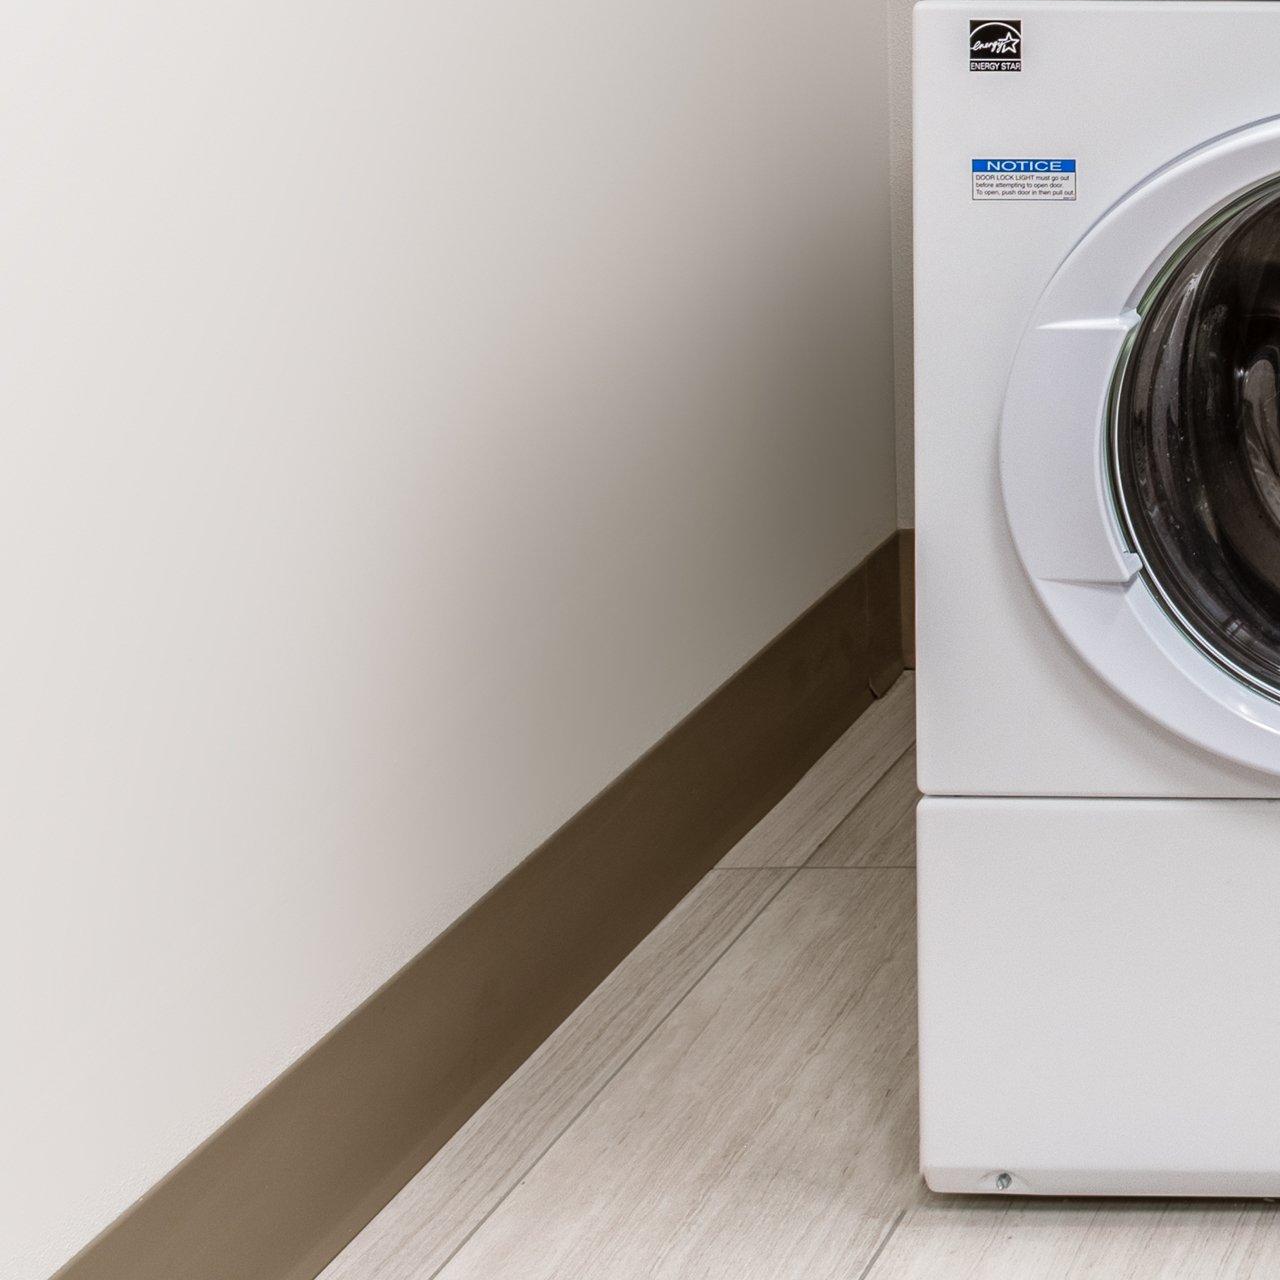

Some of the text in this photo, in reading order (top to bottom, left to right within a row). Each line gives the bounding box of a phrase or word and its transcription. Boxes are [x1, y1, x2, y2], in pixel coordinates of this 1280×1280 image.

[970, 62, 1020, 70] ENERGY STAR
[987, 161, 1062, 171] NOTICE
